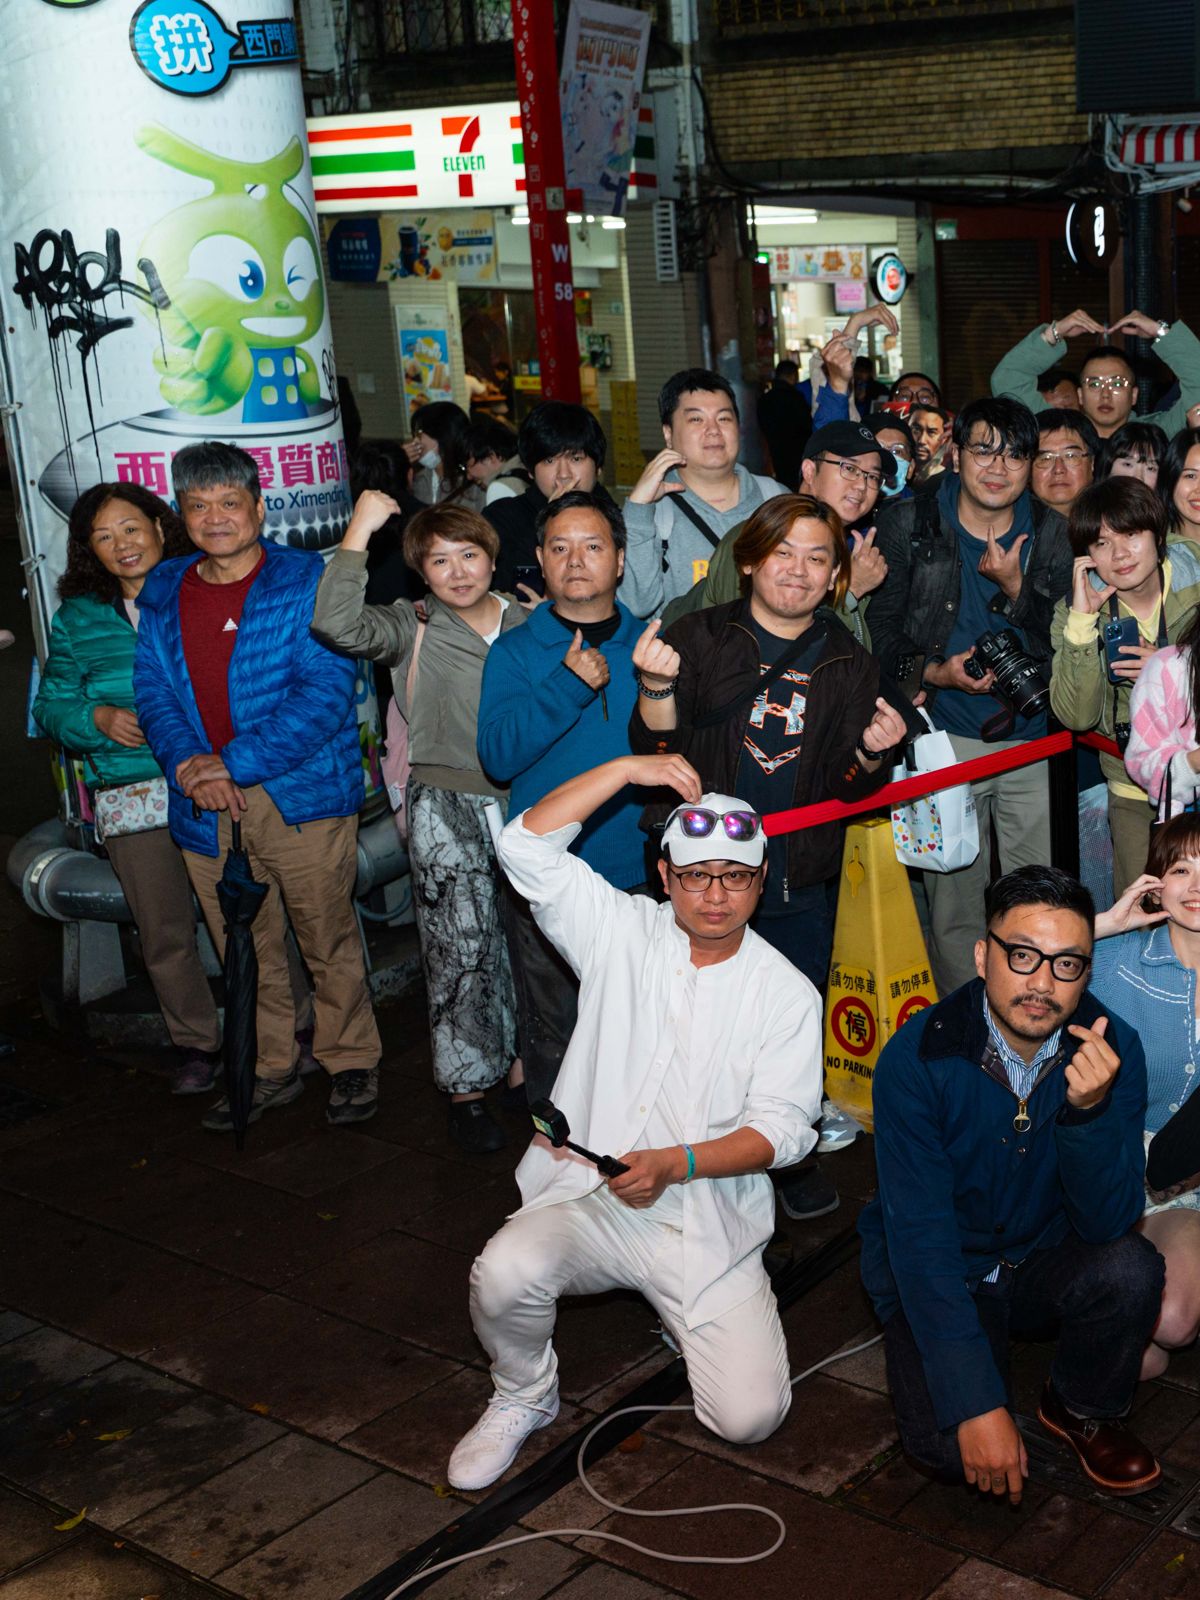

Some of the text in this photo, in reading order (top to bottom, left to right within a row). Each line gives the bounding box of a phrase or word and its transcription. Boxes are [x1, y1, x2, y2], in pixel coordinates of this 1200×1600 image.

[151, 13, 212, 75] 拼
[551, 244, 569, 263] W
[554, 282, 573, 300] 58
[265, 495, 285, 511] to
[830, 971, 876, 995] 請勿停車
[889, 969, 932, 999] 請勿停車
[845, 1010, 867, 1043] 停
[826, 1055, 875, 1080] NO PARKIN
